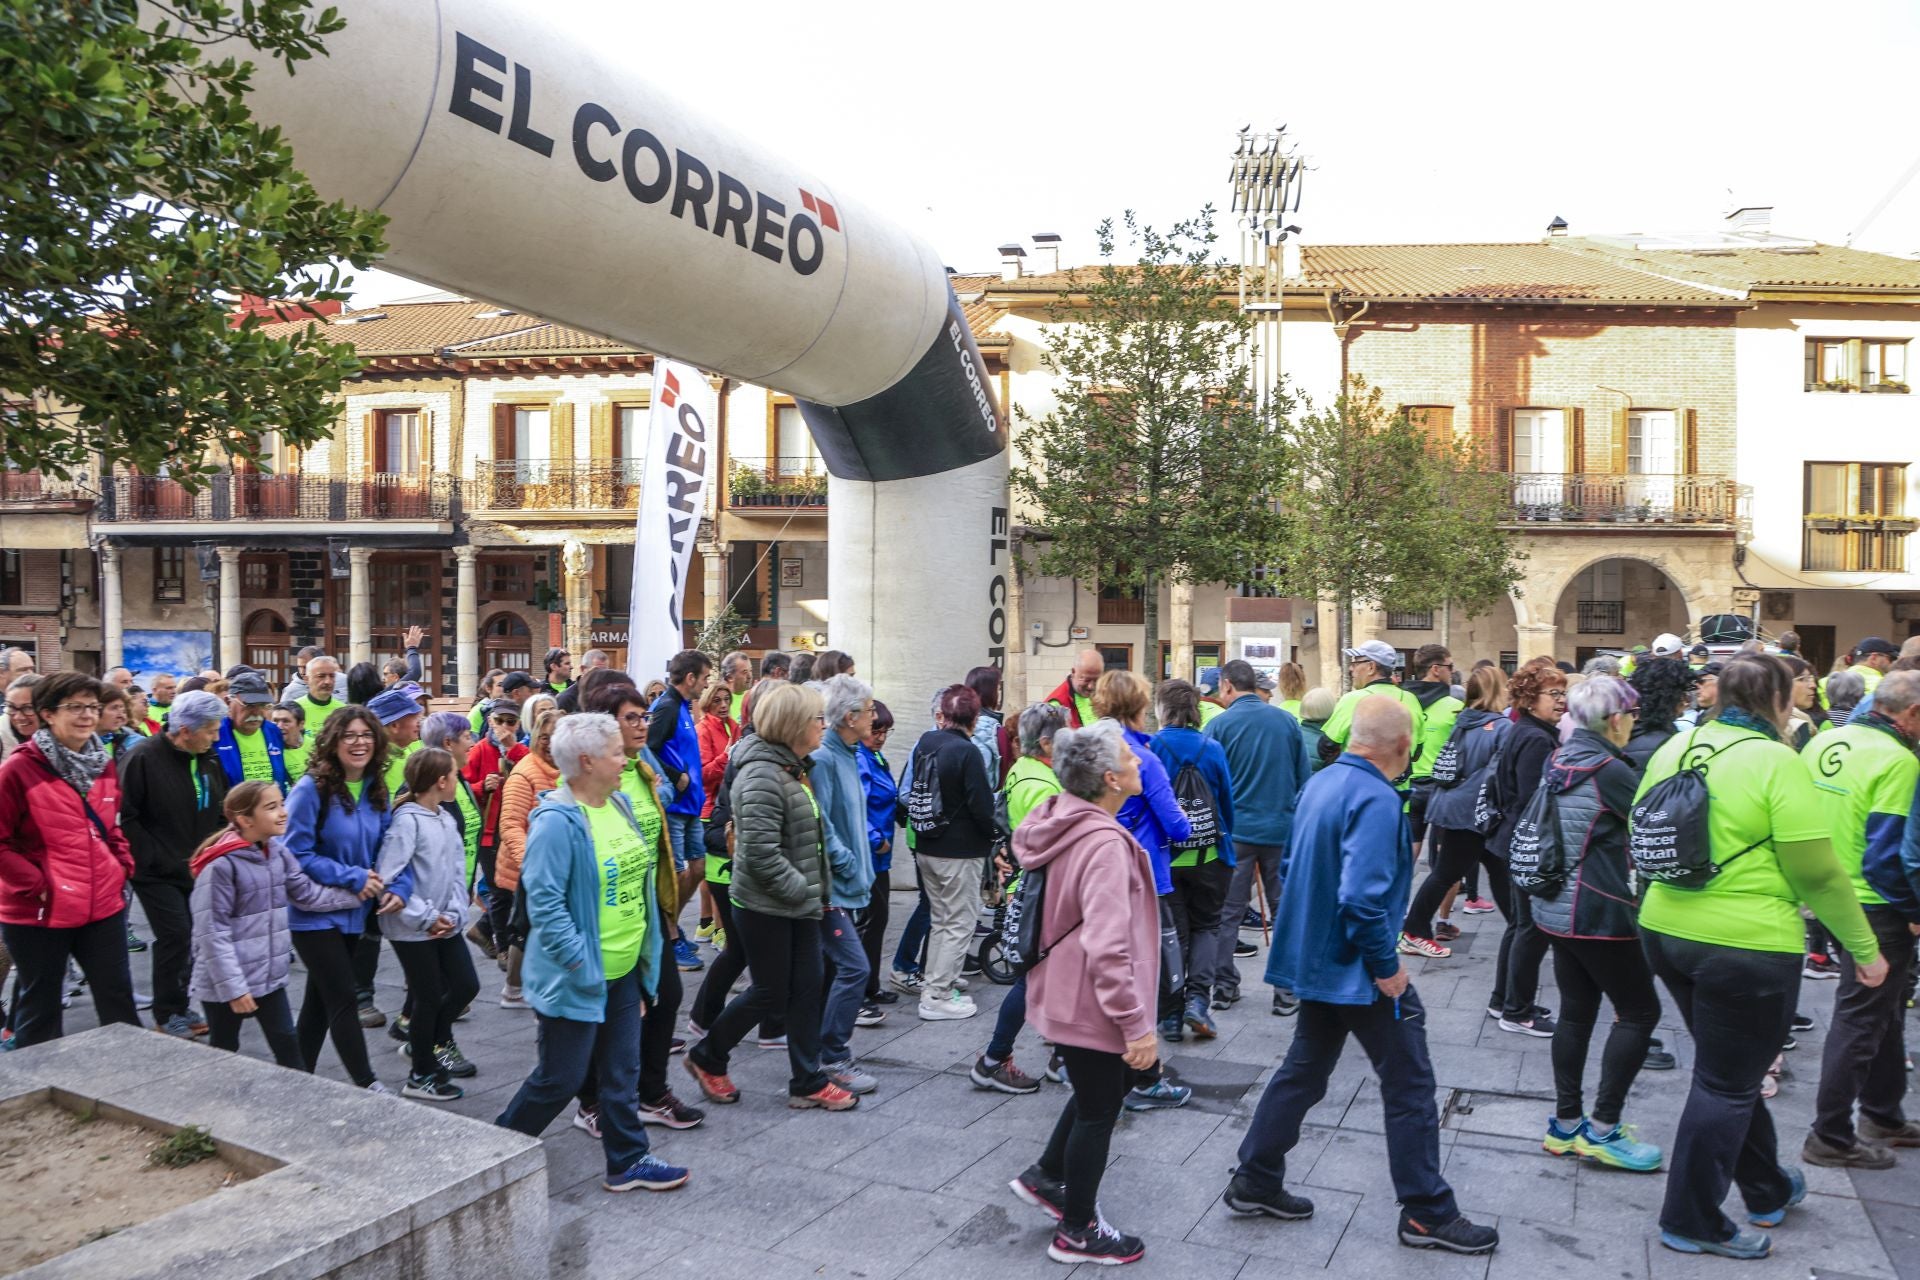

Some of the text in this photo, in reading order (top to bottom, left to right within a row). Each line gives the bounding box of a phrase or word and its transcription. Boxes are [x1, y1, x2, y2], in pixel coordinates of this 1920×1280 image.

[448, 30, 825, 276] EL CORREO
[949, 320, 997, 432] EL CORREO
[990, 507, 1008, 566] EL
[603, 856, 619, 907] ARABA
